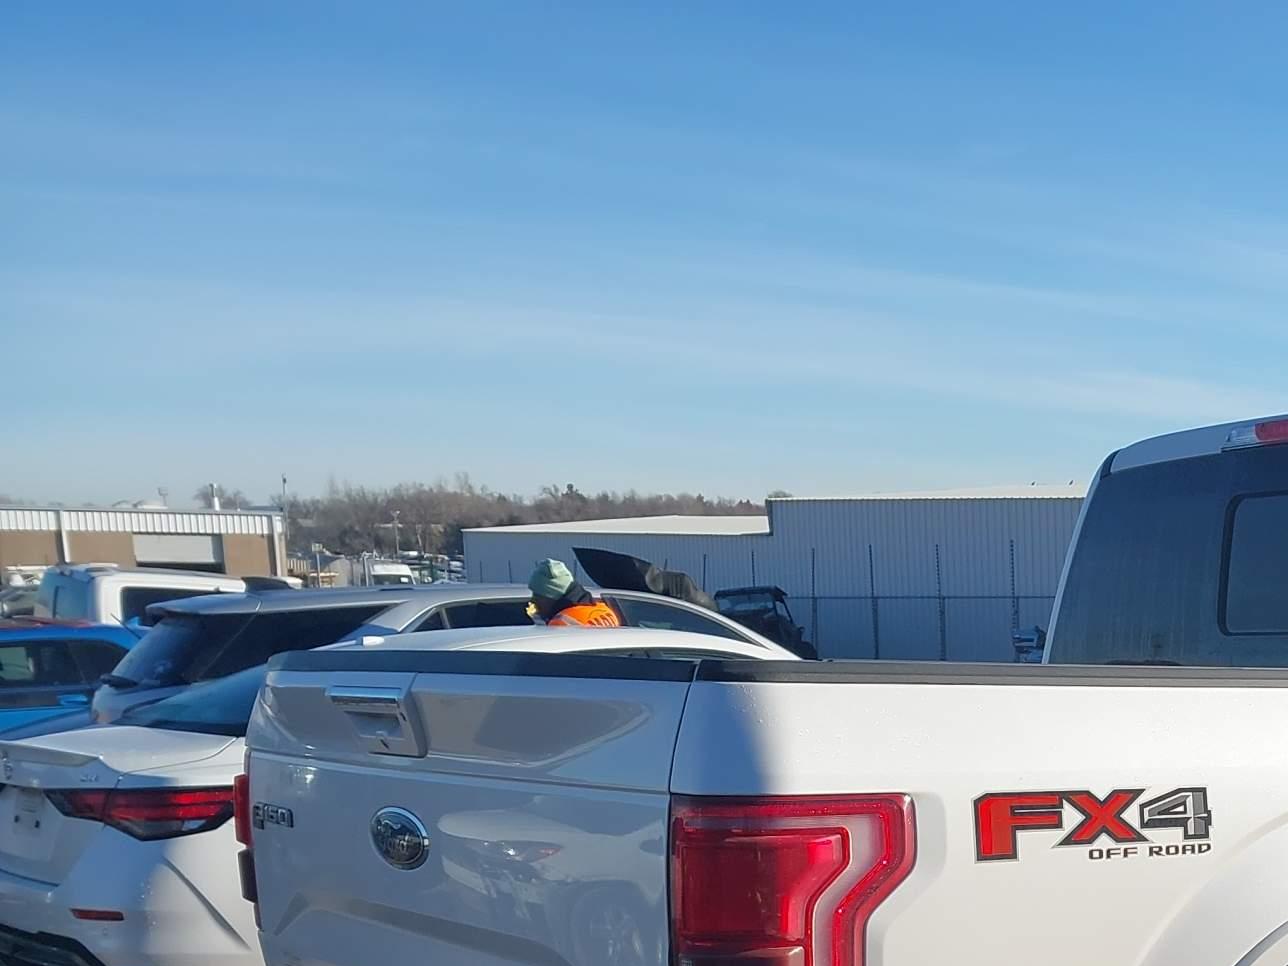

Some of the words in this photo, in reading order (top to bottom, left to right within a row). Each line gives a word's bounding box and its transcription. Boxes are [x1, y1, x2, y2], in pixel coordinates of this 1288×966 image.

[972, 786, 1212, 862] FX4
[1088, 846, 1139, 861] OFF
[1148, 842, 1212, 858] ROAD
